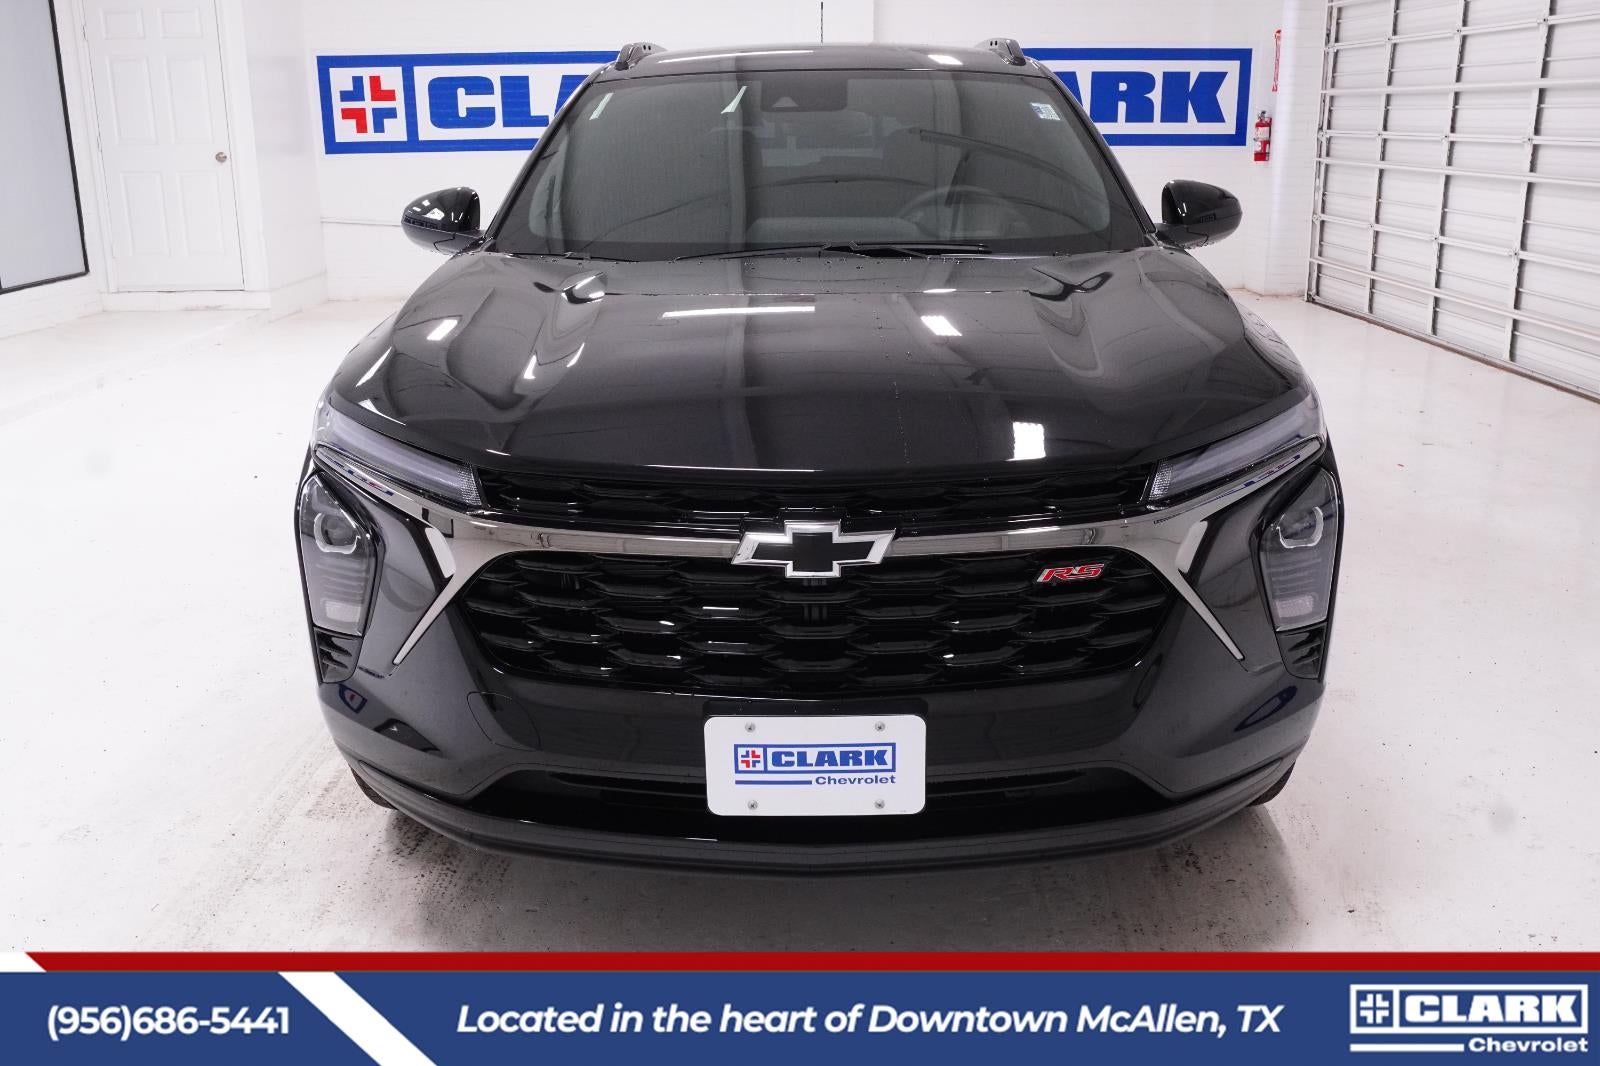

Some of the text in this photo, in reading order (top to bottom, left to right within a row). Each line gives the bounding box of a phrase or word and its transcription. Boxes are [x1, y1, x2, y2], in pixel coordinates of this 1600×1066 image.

[1036, 563, 1105, 583] RS
[771, 749, 889, 768] CLARK
[815, 775, 896, 785] Chevrolet
